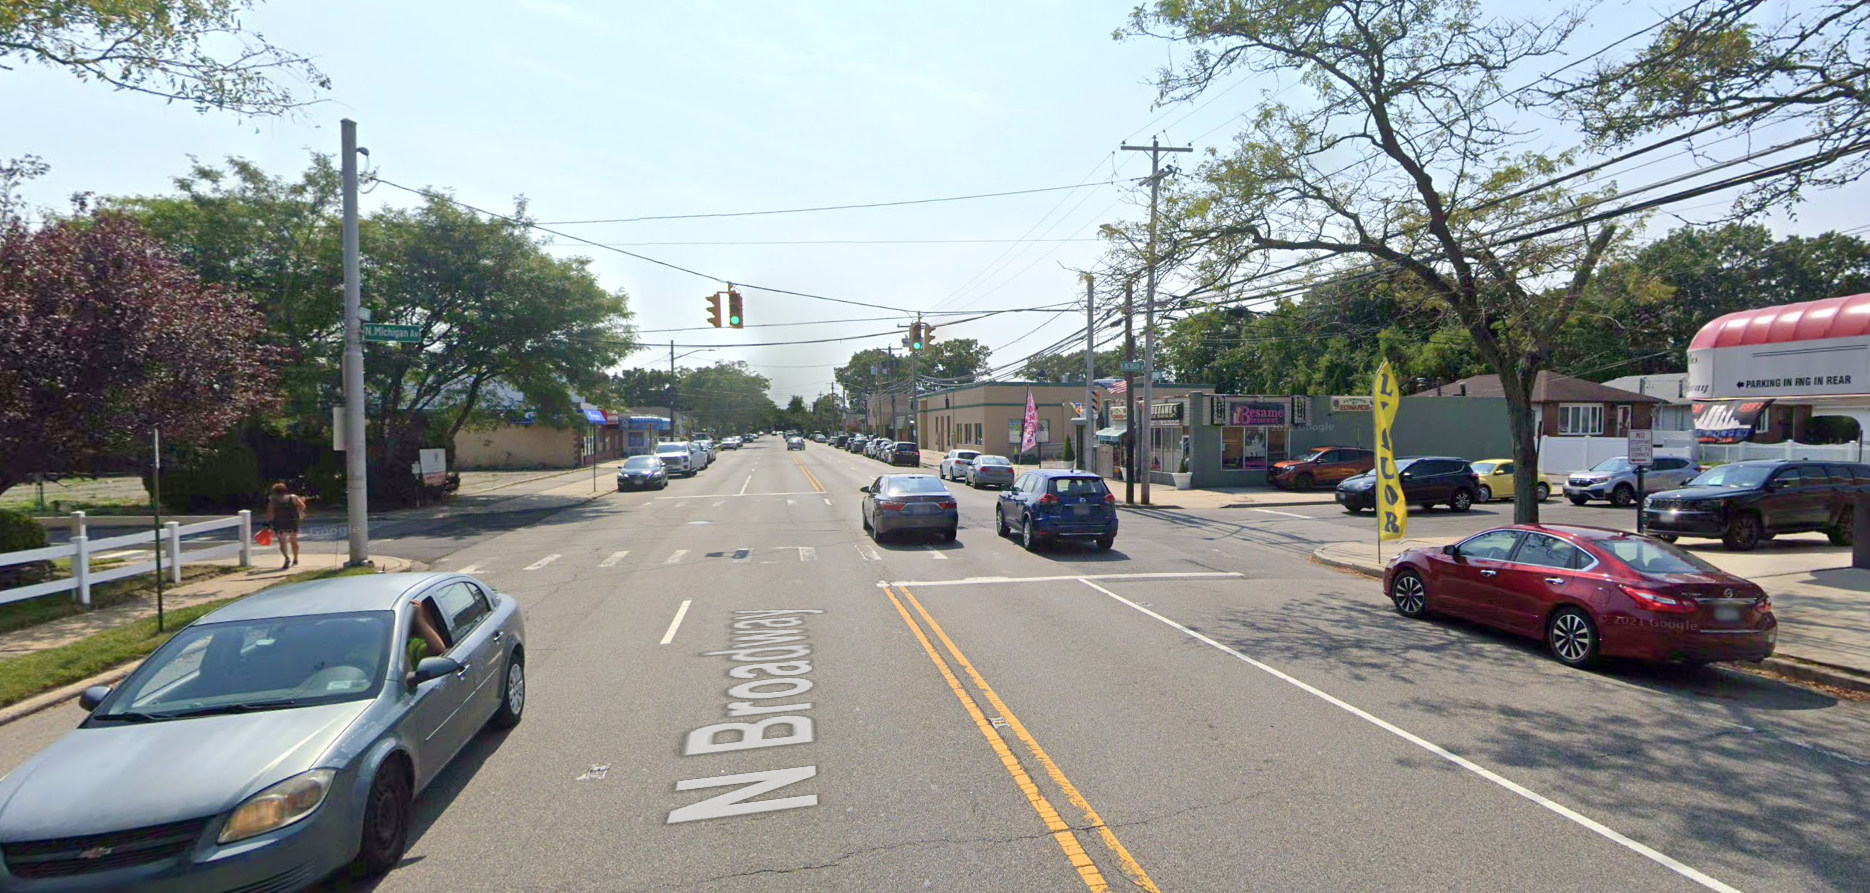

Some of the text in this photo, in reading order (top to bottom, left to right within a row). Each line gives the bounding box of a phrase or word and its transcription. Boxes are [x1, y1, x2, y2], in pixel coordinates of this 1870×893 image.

[374, 326, 409, 338] Michigan
[1746, 378, 1781, 388] PARKING
[1783, 377, 1792, 387] IN
[1814, 376, 1824, 386] IN
[1826, 375, 1852, 386] REAR
[1241, 405, 1284, 425] Besame
